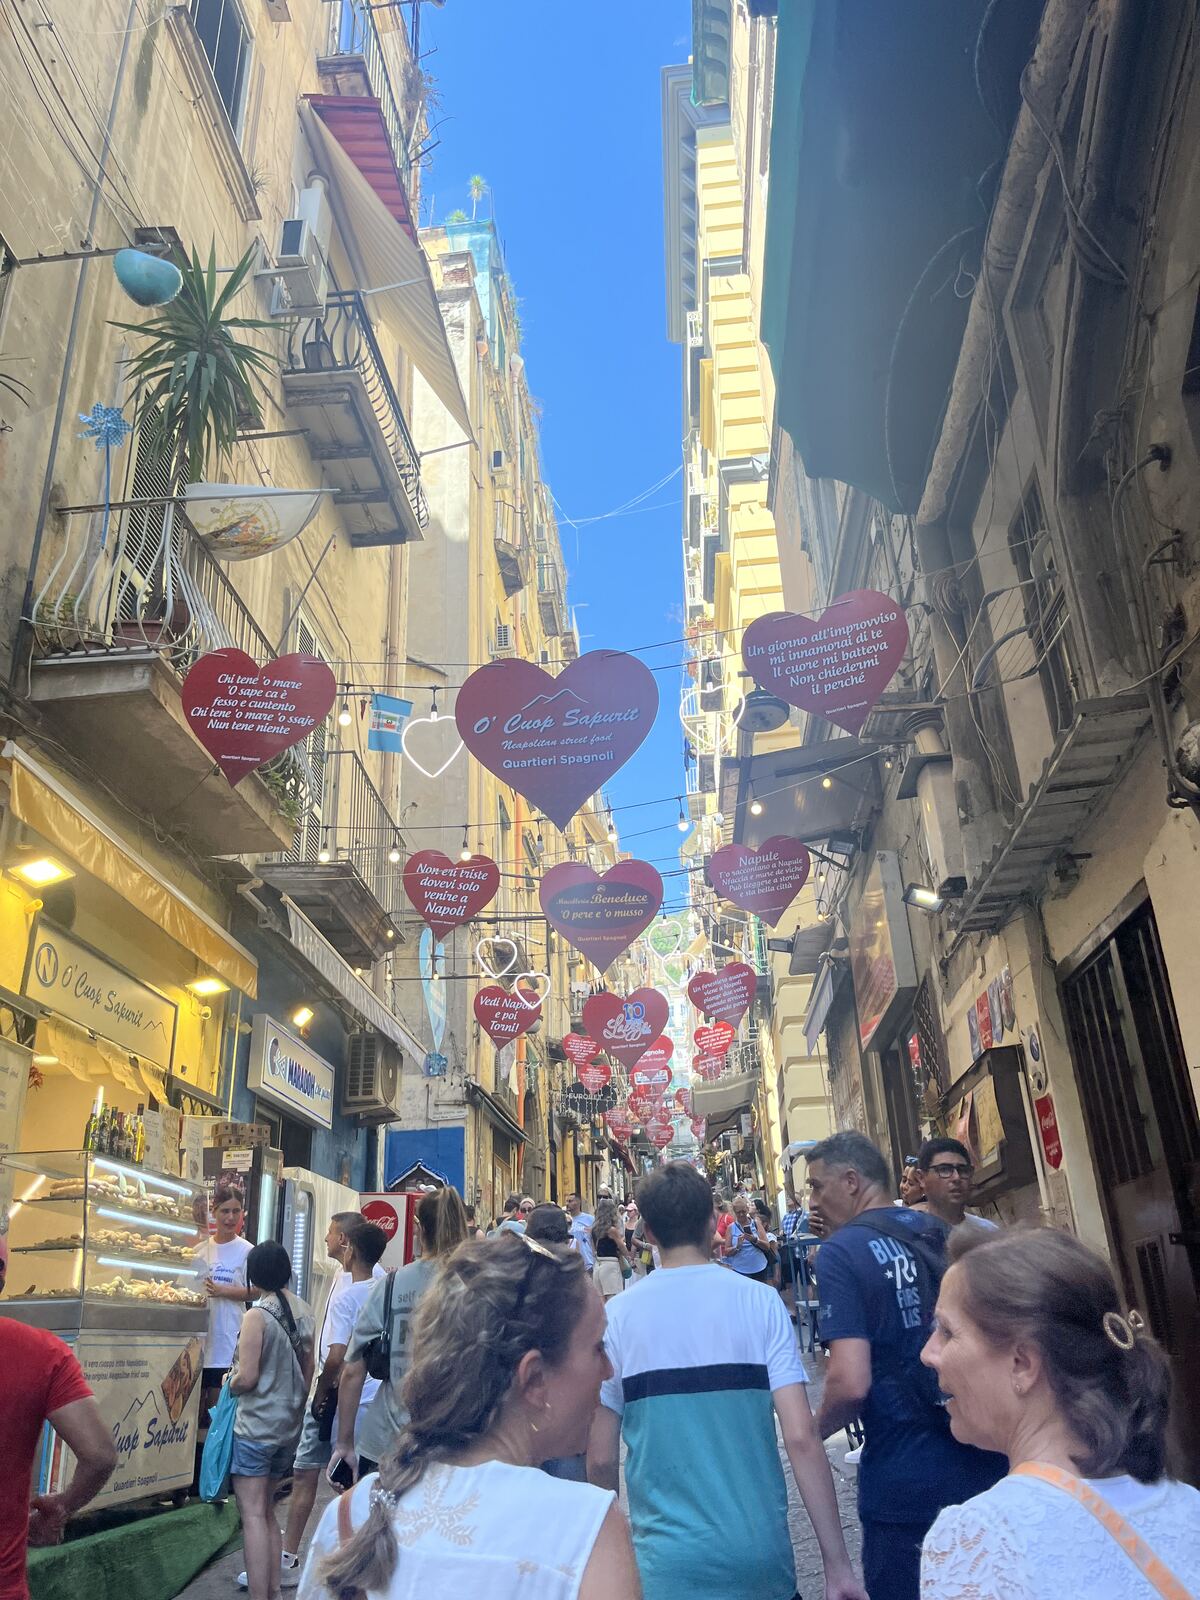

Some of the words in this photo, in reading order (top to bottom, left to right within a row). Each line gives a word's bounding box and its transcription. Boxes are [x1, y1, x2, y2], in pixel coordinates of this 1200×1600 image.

[747, 646, 765, 657] Un
[768, 637, 808, 655] giorno
[811, 612, 897, 643] all'improvviso
[769, 653, 786, 666] mi
[788, 636, 854, 660] innamorai
[856, 632, 868, 644] di
[871, 629, 884, 640] te
[785, 661, 820, 675] cuore
[822, 653, 839, 666] mi
[841, 641, 889, 661] batteva
[790, 674, 816, 687] Non
[818, 655, 880, 680] chiedermi
[217, 673, 234, 684] Chi
[236, 675, 258, 685] tene
[262, 676, 270, 686] 'o
[272, 680, 302, 690] mare
[811, 684, 821, 695] il
[824, 672, 866, 695] perché
[227, 685, 237, 696] 'O
[239, 688, 264, 699] sape
[265, 690, 278, 699] ca
[280, 689, 288, 700] è
[211, 697, 239, 708] fesso
[239, 700, 247, 708] e
[248, 699, 296, 712] cuntento
[190, 706, 208, 717] Chi
[209, 708, 231, 718] tene
[235, 709, 243, 718] 'o
[244, 711, 274, 721] mare
[278, 713, 286, 722] 'o
[287, 716, 315, 727] ssaje
[473, 715, 497, 734] O'
[503, 713, 556, 735] Cuop
[562, 707, 641, 729] Sapurit
[206, 719, 229, 730] Nun
[231, 721, 254, 732] tene
[255, 723, 290, 735] niente
[501, 739, 558, 751] Neapolitan
[559, 736, 588, 746] street
[589, 732, 614, 745] food
[502, 755, 557, 769] Quartieri
[560, 751, 614, 765] Spagnoli
[739, 851, 780, 867] Napule
[778, 858, 803, 867] Napule
[416, 863, 439, 875] Non
[441, 868, 457, 877] eri
[459, 868, 489, 881] triste
[419, 876, 457, 890] dovevi
[457, 881, 480, 892] solo
[424, 890, 459, 902] venire
[460, 895, 469, 904] a
[590, 892, 648, 904] Beneduce
[424, 901, 467, 917] Napoli
[572, 911, 594, 921] pere
[604, 908, 612, 918] 'o
[613, 909, 645, 918] musso
[74, 971, 102, 1008] Cuop
[104, 990, 144, 1028] Sapurit
[479, 995, 501, 1007] Vedi
[501, 1011, 518, 1021] poi
[489, 1020, 520, 1033] Torni!
[143, 1417, 190, 1453] Sapurit
